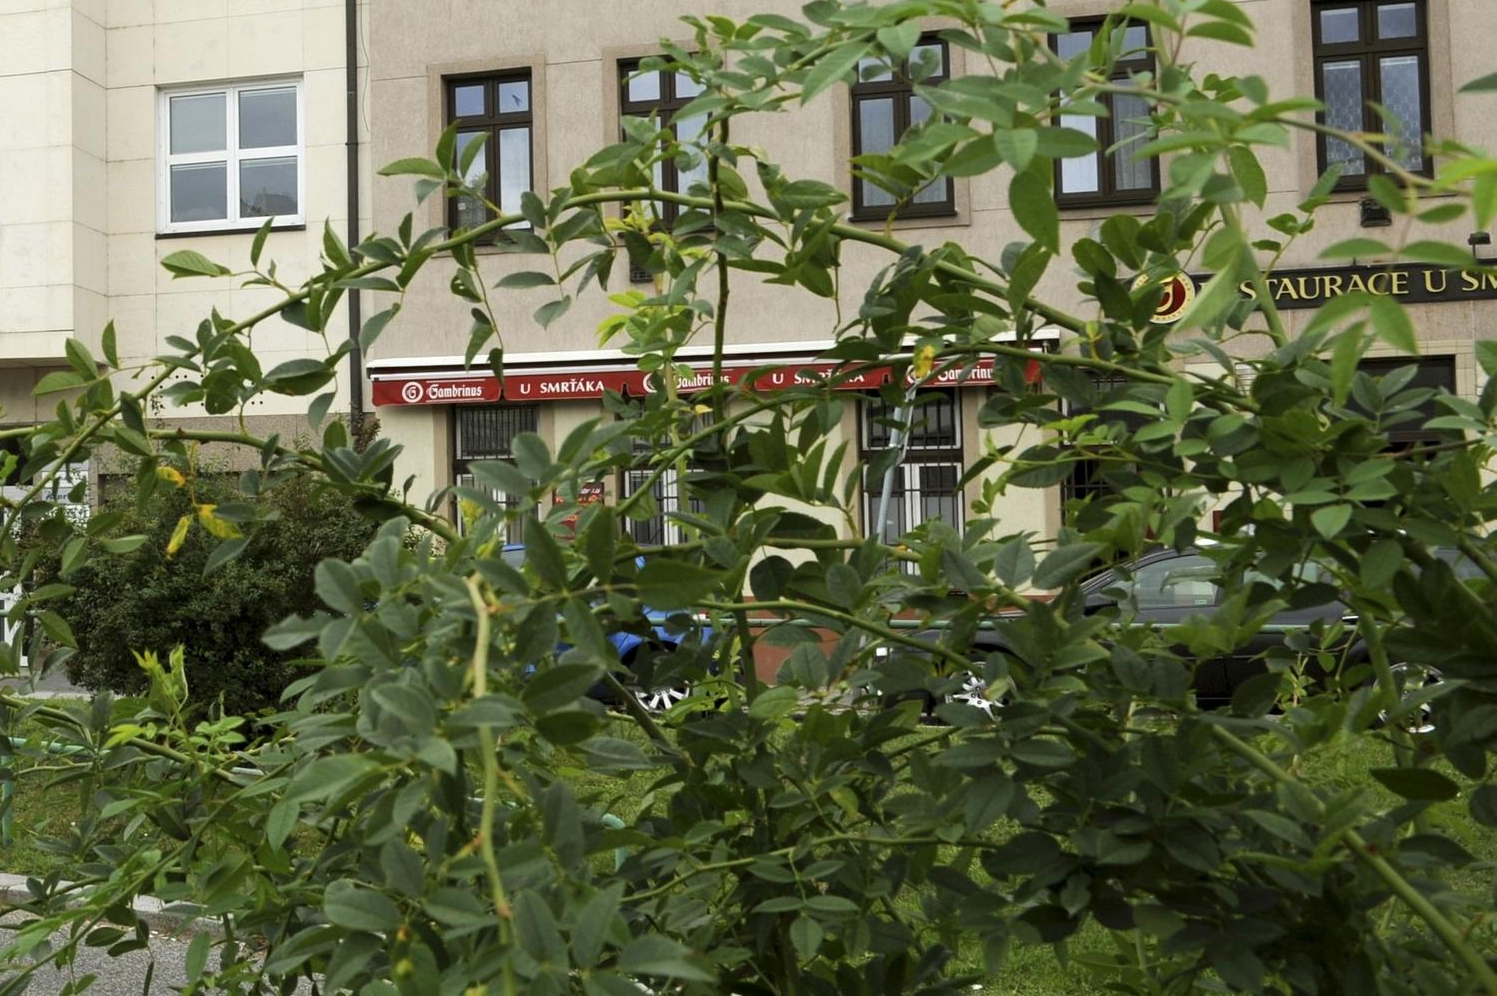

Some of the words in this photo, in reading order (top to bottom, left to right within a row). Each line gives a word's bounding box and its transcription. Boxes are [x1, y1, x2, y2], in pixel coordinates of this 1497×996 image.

[1199, 271, 1409, 302] STAURACE
[1423, 269, 1447, 293] U
[520, 383, 531, 395] U
[539, 378, 605, 394] SMRŤÁKA
[772, 372, 784, 385] U
[426, 383, 483, 399] Gambrinus
